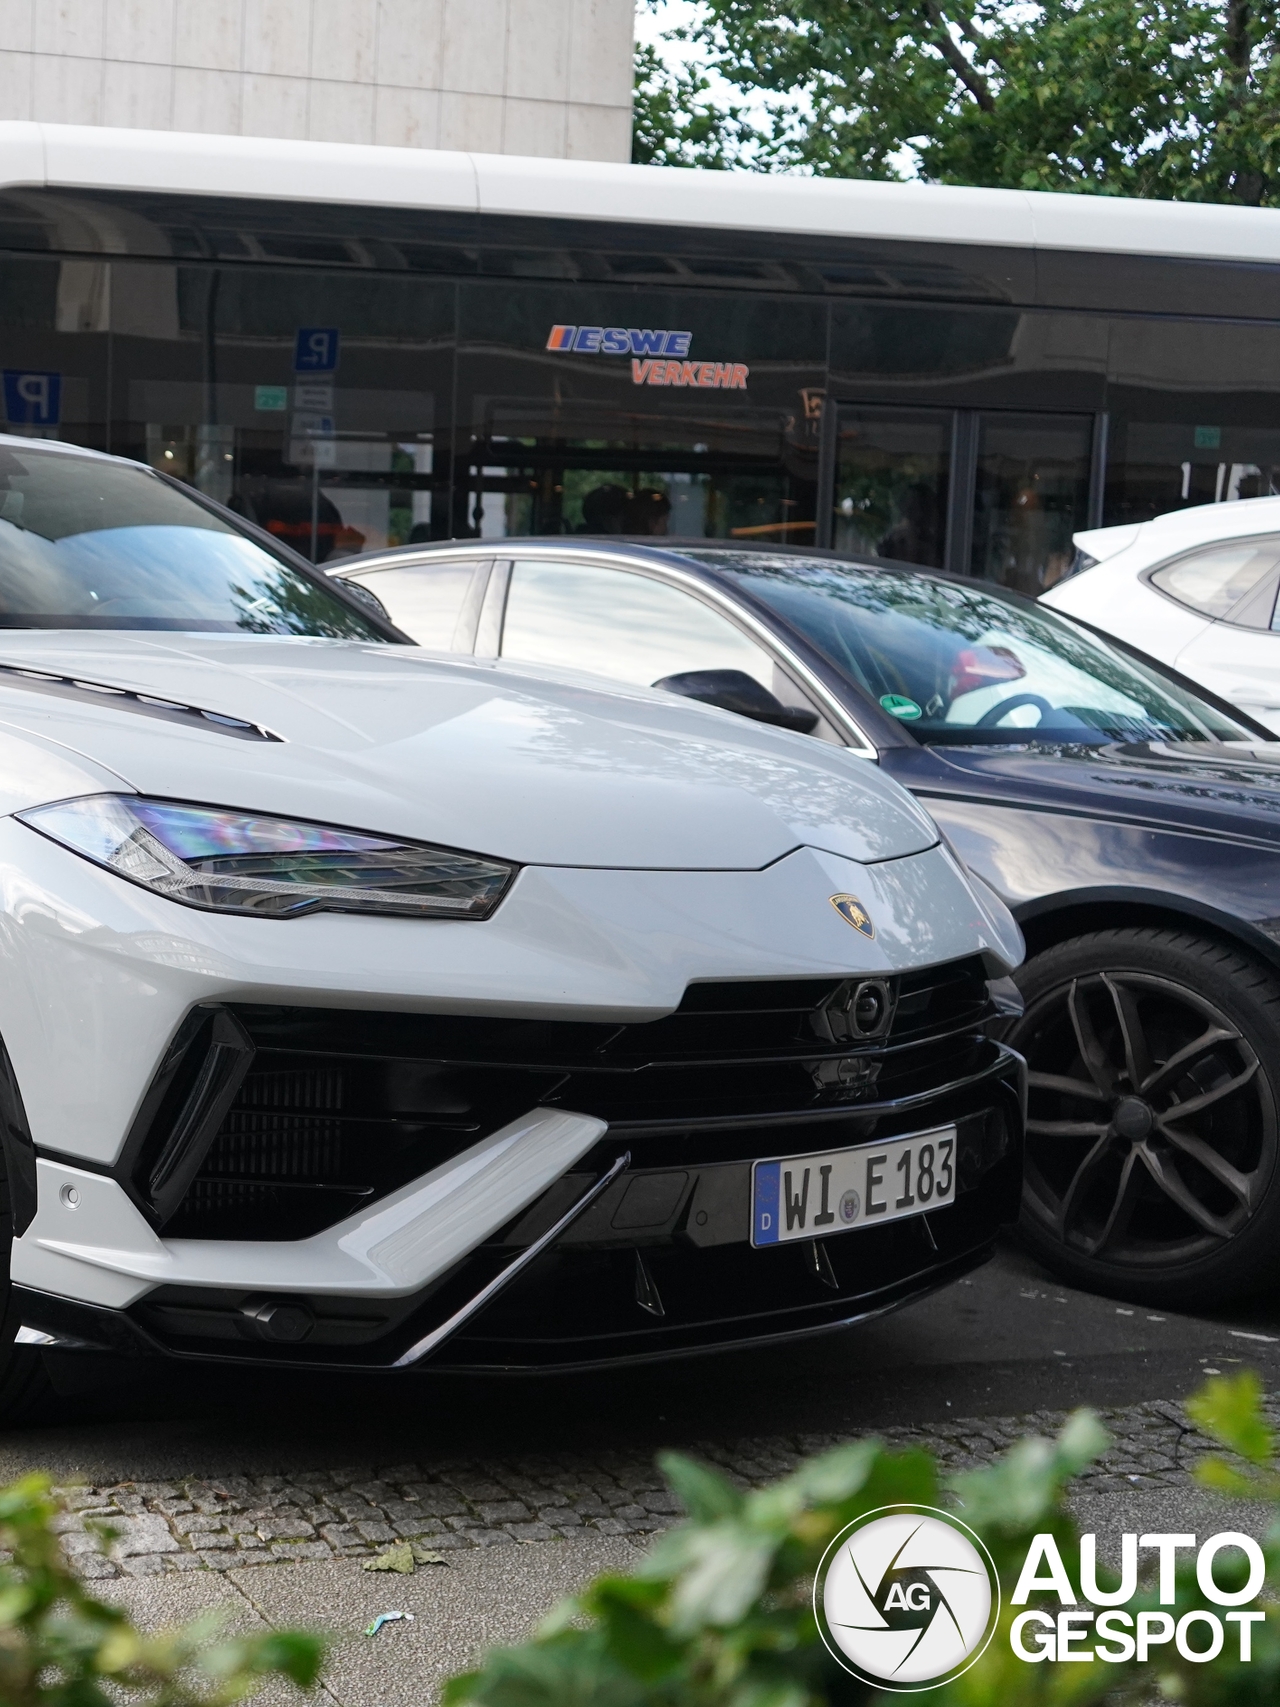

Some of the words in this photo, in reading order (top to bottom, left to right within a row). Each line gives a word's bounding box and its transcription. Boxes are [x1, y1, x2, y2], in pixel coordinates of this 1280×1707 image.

[573, 326, 692, 357] ESWE
[631, 358, 749, 389] VERKEHR
[760, 1212, 772, 1231] D
[784, 1164, 835, 1231] WI
